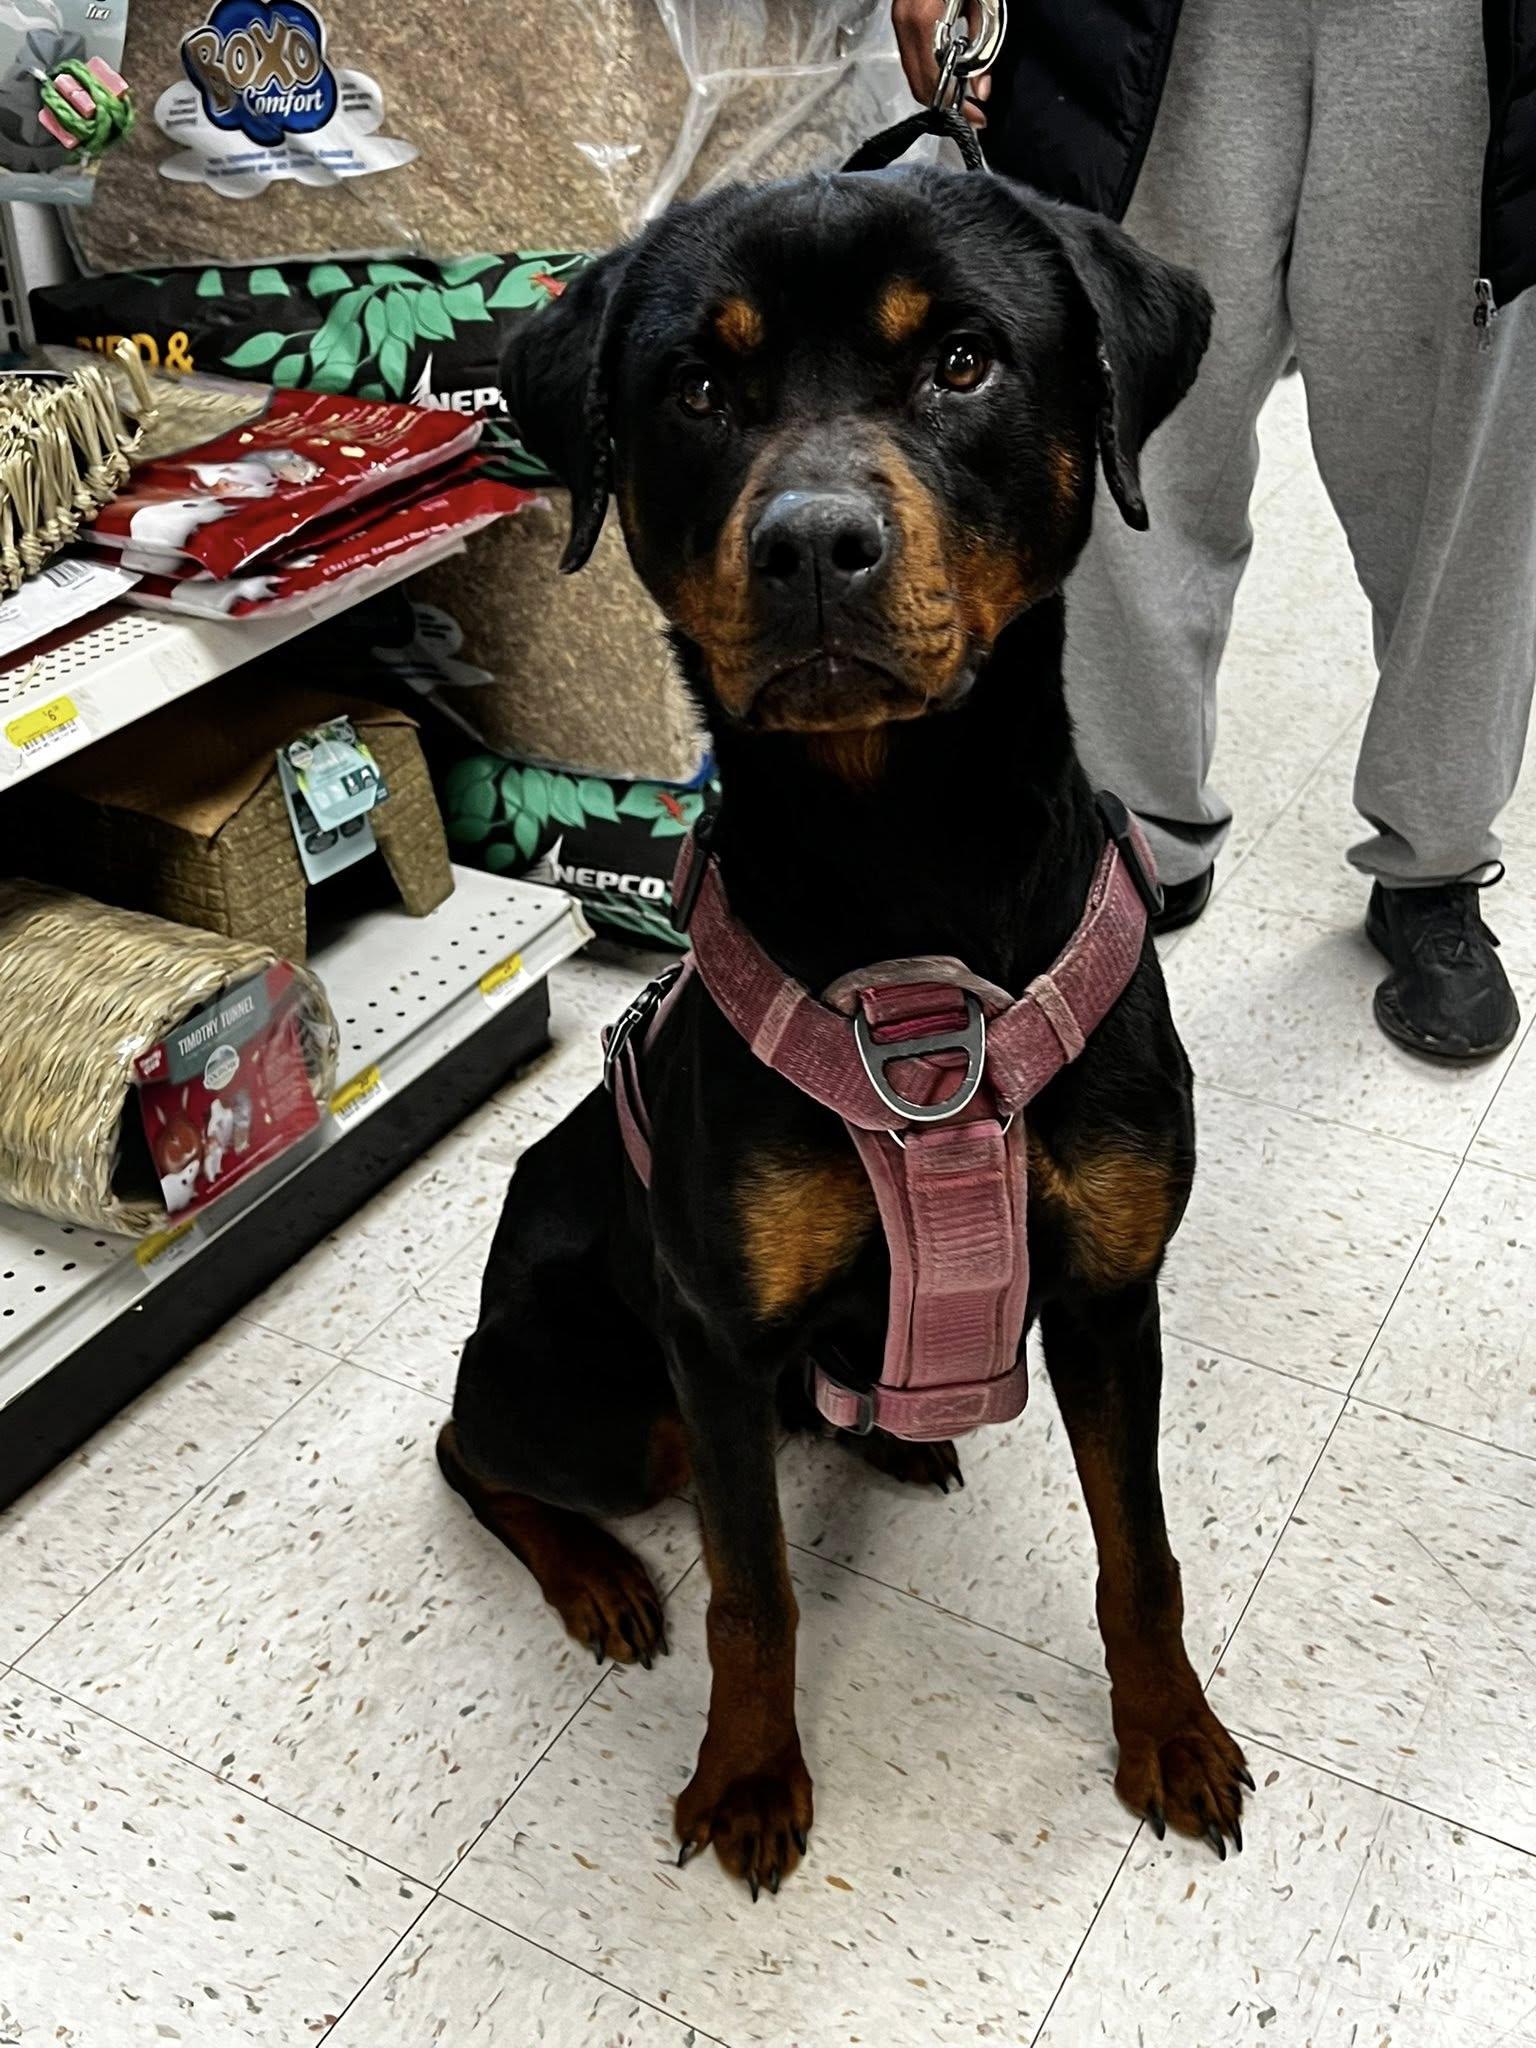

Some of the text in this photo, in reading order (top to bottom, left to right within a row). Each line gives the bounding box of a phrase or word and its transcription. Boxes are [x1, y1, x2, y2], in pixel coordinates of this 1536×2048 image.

[243, 86, 324, 117] Comfort
[553, 862, 665, 900] NEPCO
[178, 995, 255, 1056] TIMOTHY TUNNEL
